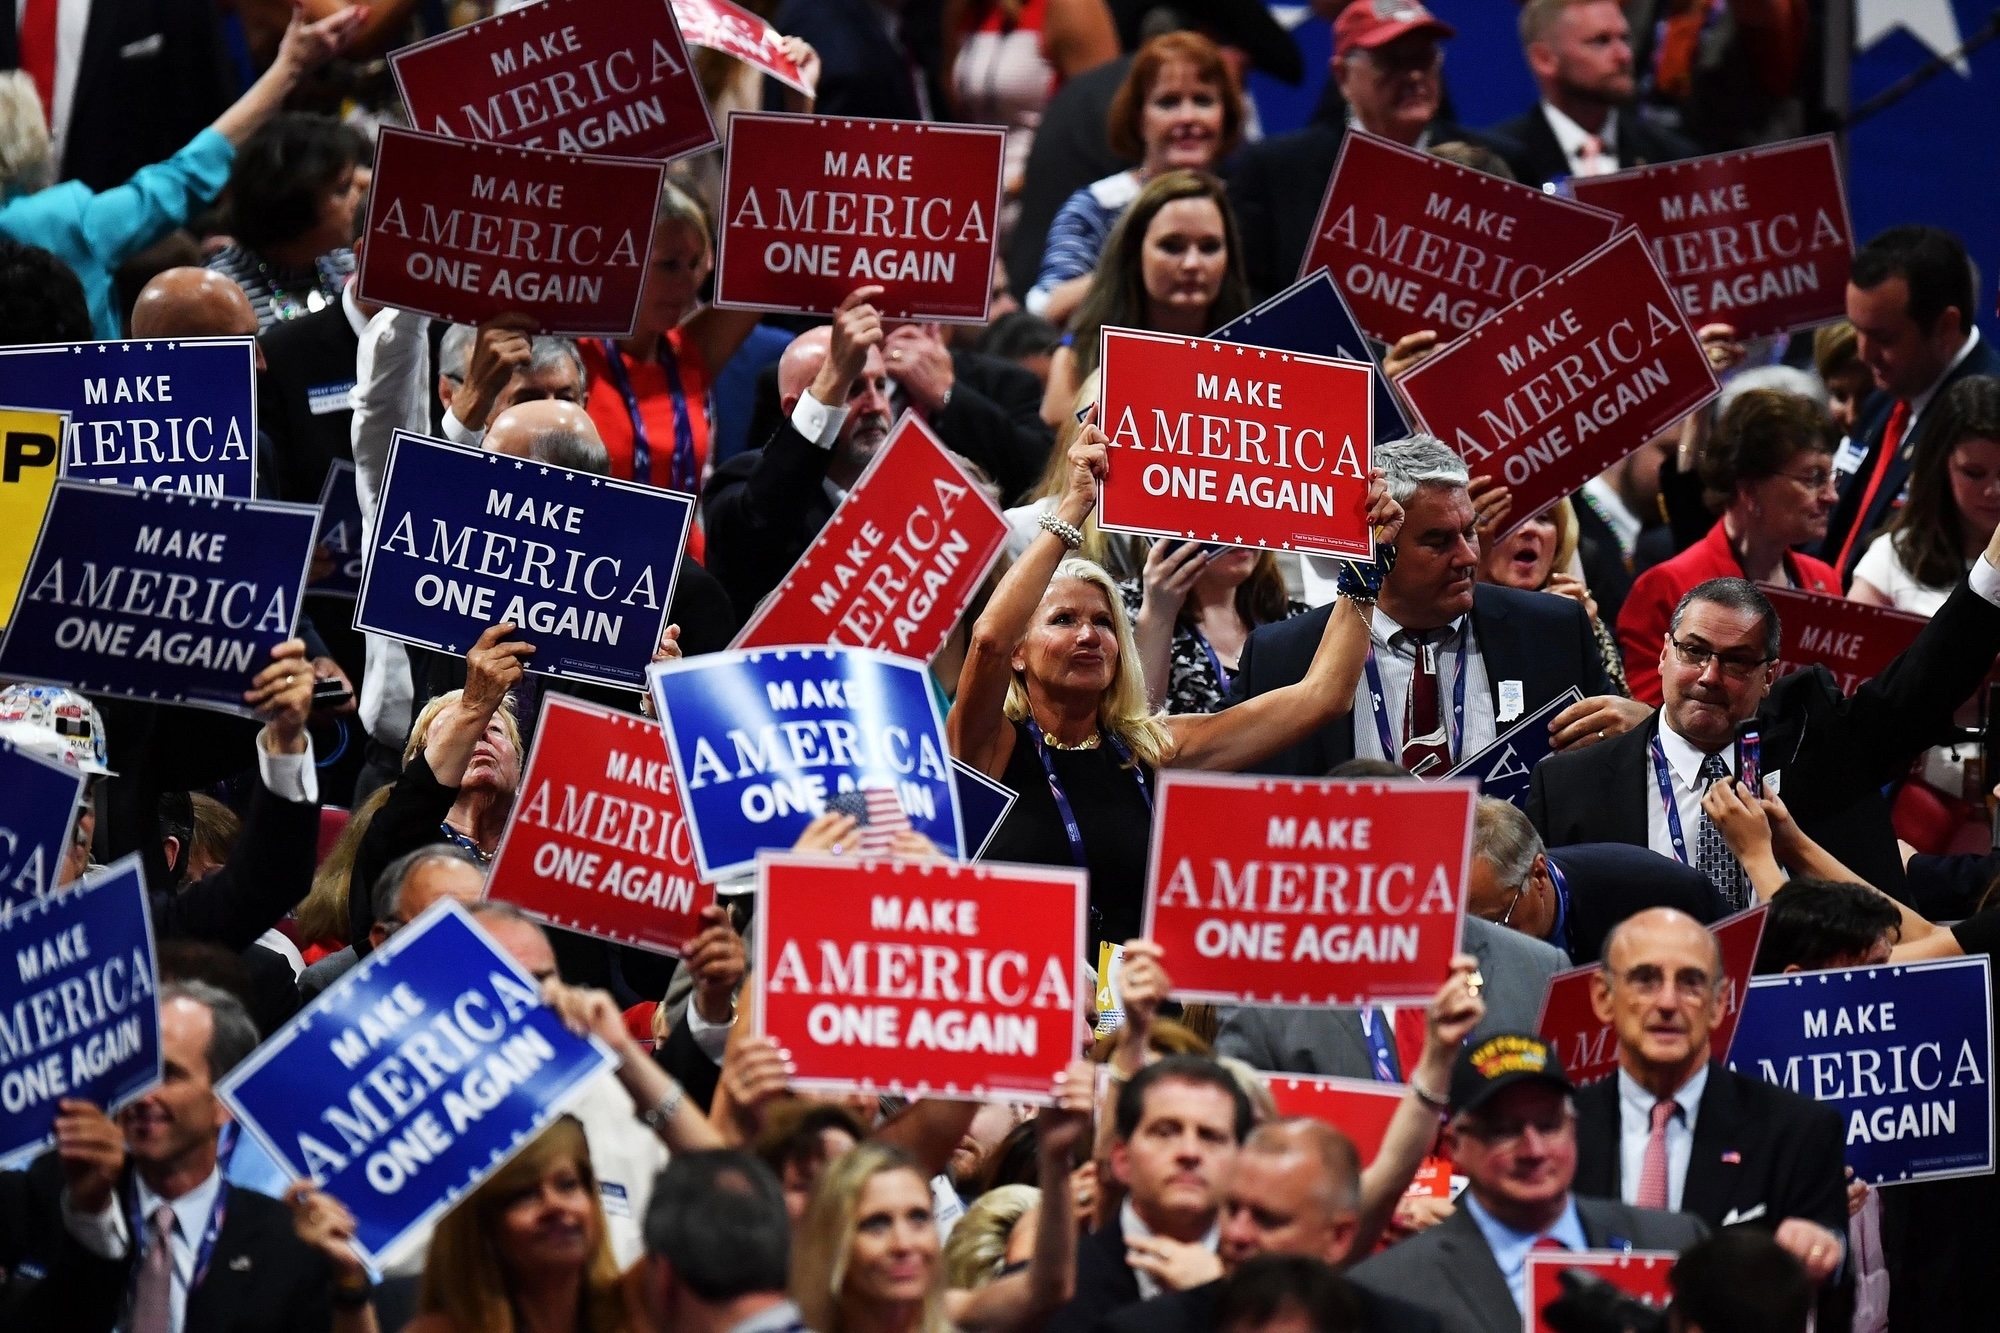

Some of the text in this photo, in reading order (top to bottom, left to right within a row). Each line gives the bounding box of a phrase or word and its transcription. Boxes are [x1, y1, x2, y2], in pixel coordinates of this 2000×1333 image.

[490, 26, 582, 77] MAKE
[559, 95, 667, 154] AGAIN
[471, 174, 564, 209] MAKE
[824, 151, 913, 181] MAKE
[730, 186, 989, 243] AMERICA
[1425, 192, 1517, 241] MAKE
[1660, 183, 1750, 220] MAKE
[374, 197, 640, 267] AMERICA
[1323, 204, 1546, 301] AMERIC
[1651, 206, 1843, 279] ERICA
[406, 252, 602, 304] ONE AGAIN
[764, 241, 956, 283] ONE AGAIN
[1709, 260, 1821, 311] AGAIN
[1346, 263, 1498, 330] ONE AGA
[1497, 307, 1583, 376] MAKE
[84, 375, 173, 405] MAKE
[1197, 373, 1282, 409] MAKE
[1456, 301, 1681, 469] AMERICA
[69, 416, 249, 467] ERICA
[1109, 405, 1365, 480] AMERICA
[1503, 425, 1573, 485] ONE
[1574, 358, 1671, 443] AGAIN
[485, 489, 584, 534] MAKE
[1142, 464, 1334, 517] ONE AGAIN
[134, 525, 227, 562] MAKE
[380, 511, 660, 610] AMERICA
[810, 519, 885, 616] MAKE
[826, 477, 969, 651] ERICA
[27, 557, 288, 634] AMERICA
[415, 574, 623, 645] ONE AGAIN
[892, 528, 970, 650] AGAIN
[55, 617, 256, 673] ONE AGAIN
[1799, 624, 1864, 660] MAKE
[766, 680, 861, 711] MAKE
[606, 749, 672, 794] MAKE
[689, 719, 947, 791] AMERCA
[519, 778, 695, 867] AMERIC
[1266, 815, 1372, 851] MAKE
[533, 842, 696, 916] ONE AGAIN
[1159, 856, 1455, 916] AMERICA
[871, 895, 979, 936] MAKE
[1194, 917, 1419, 963] ONE AGAIN
[17, 923, 90, 983] MAKE
[768, 938, 1072, 1011] AMERICA
[0, 945, 154, 1068] MERICA
[330, 981, 426, 1070] MAKE
[807, 1002, 1038, 1057] ONE AGAIN
[1803, 1002, 1896, 1039] MAKE
[1, 1015, 143, 1114] ONE AGAIN
[298, 970, 540, 1187] AMERICA
[1729, 1038, 1985, 1101] MERICA
[366, 1024, 555, 1194] ONE AGAIN
[1845, 1099, 1956, 1145] AGAIN
